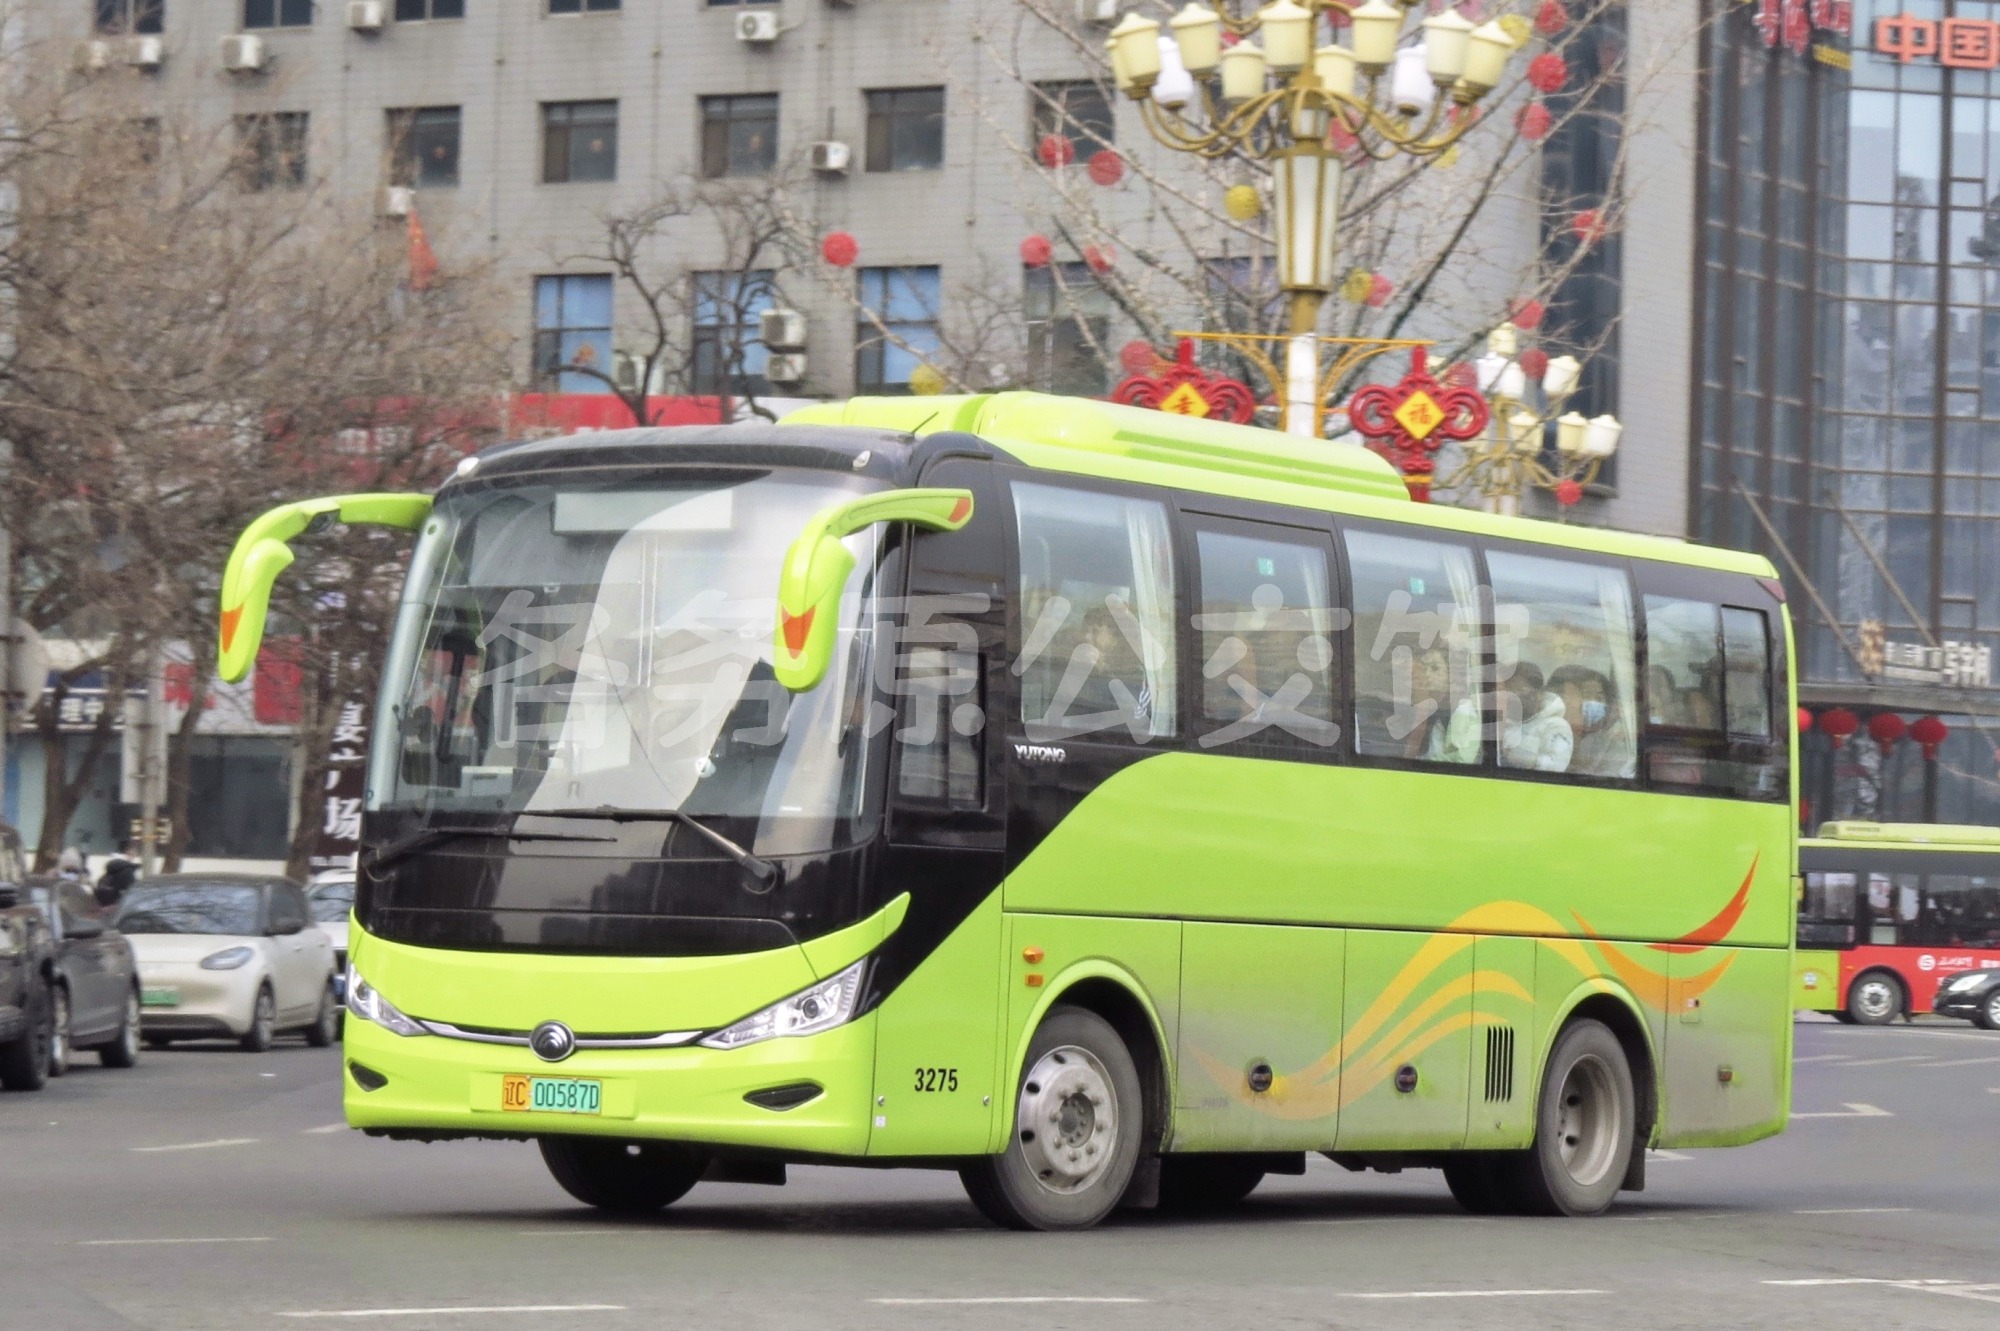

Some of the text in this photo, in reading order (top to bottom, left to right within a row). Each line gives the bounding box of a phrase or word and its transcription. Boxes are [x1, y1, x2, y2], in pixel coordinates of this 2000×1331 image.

[1875, 12, 1999, 69] 中国
[1013, 744, 1066, 762] YUTONG
[914, 1067, 958, 1092] 3275
